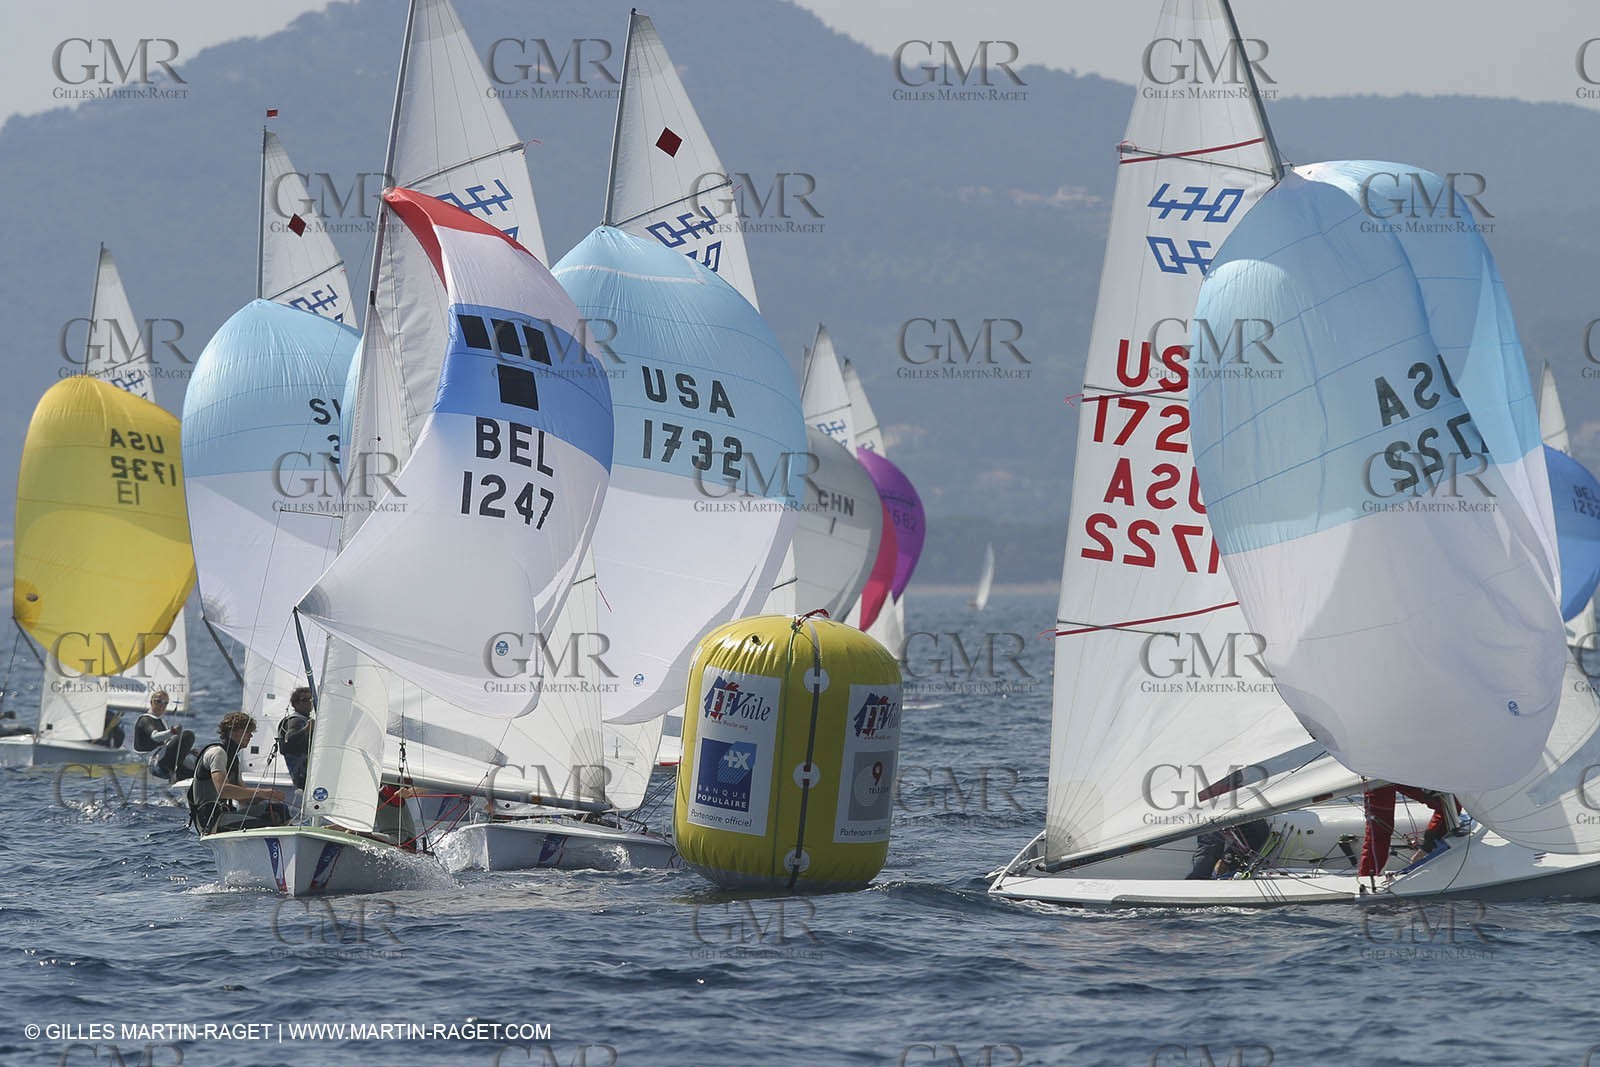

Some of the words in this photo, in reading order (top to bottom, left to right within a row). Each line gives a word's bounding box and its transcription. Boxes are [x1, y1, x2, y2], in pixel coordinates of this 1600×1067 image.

[1147, 183, 1245, 223] 470
[642, 366, 735, 418] USA
[1093, 395, 1190, 453] 172
[476, 416, 554, 477] BEL
[643, 419, 742, 479] 1732
[461, 471, 554, 530] 1247
[818, 490, 854, 517] CHN
[698, 784, 747, 800] BANQUE
[872, 761, 883, 786] 9
[697, 794, 747, 808] POPULAIRE
[725, 816, 752, 827] officiel
